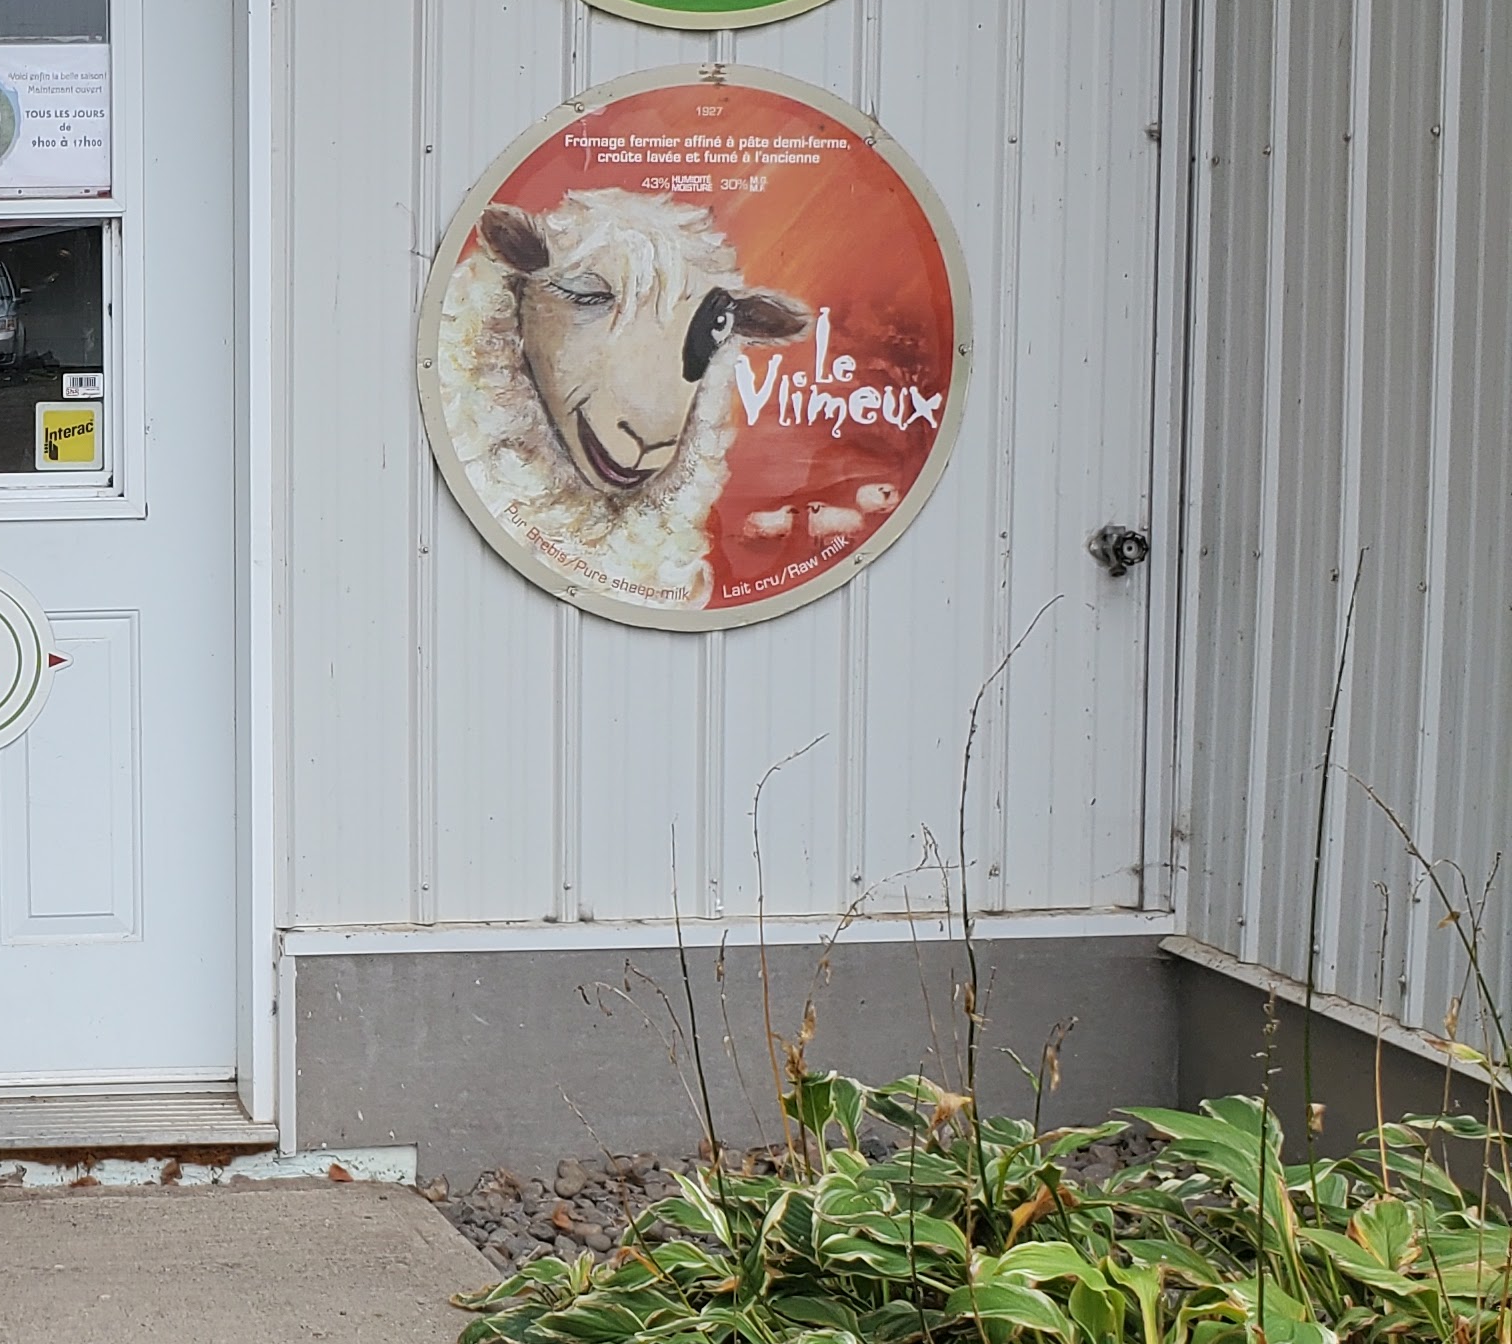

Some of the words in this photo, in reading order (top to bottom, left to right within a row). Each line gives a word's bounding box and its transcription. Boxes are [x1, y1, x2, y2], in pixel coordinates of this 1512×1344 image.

[8, 72, 28, 80] Voici
[51, 72, 59, 80] la
[28, 85, 73, 94] Maintenant
[75, 85, 102, 94] ouvert
[25, 109, 52, 119] TOUS
[54, 109, 70, 118] LES
[72, 109, 105, 118] JOURS
[696, 106, 723, 117] 1927
[59, 123, 71, 132] de
[31, 136, 56, 148] 9h00
[60, 136, 68, 147] à
[73, 135, 103, 147] 17h00
[564, 134, 626, 149] Fromage
[629, 134, 680, 148] fermier
[684, 135, 722, 148] affiné
[726, 135, 734, 148] à
[739, 136, 769, 151] pâte
[773, 135, 851, 150] demi-ferme,
[597, 151, 643, 163] croûte
[647, 151, 681, 163] lavée
[685, 152, 700, 163] et
[703, 151, 738, 163] fumé
[742, 151, 750, 163] à
[755, 151, 820, 164] l'ancienne
[641, 177, 670, 189] 43%
[671, 174, 711, 184] HUMIDITÉ
[671, 183, 713, 192] MOISTURE
[720, 179, 748, 190] 30%
[816, 307, 856, 383] Le
[735, 354, 943, 438] Vlimeux
[44, 419, 95, 442] Interac
[504, 501, 527, 527] Pur
[660, 587, 690, 601] milk
[722, 582, 752, 598] Lait
[821, 535, 850, 561] milk
